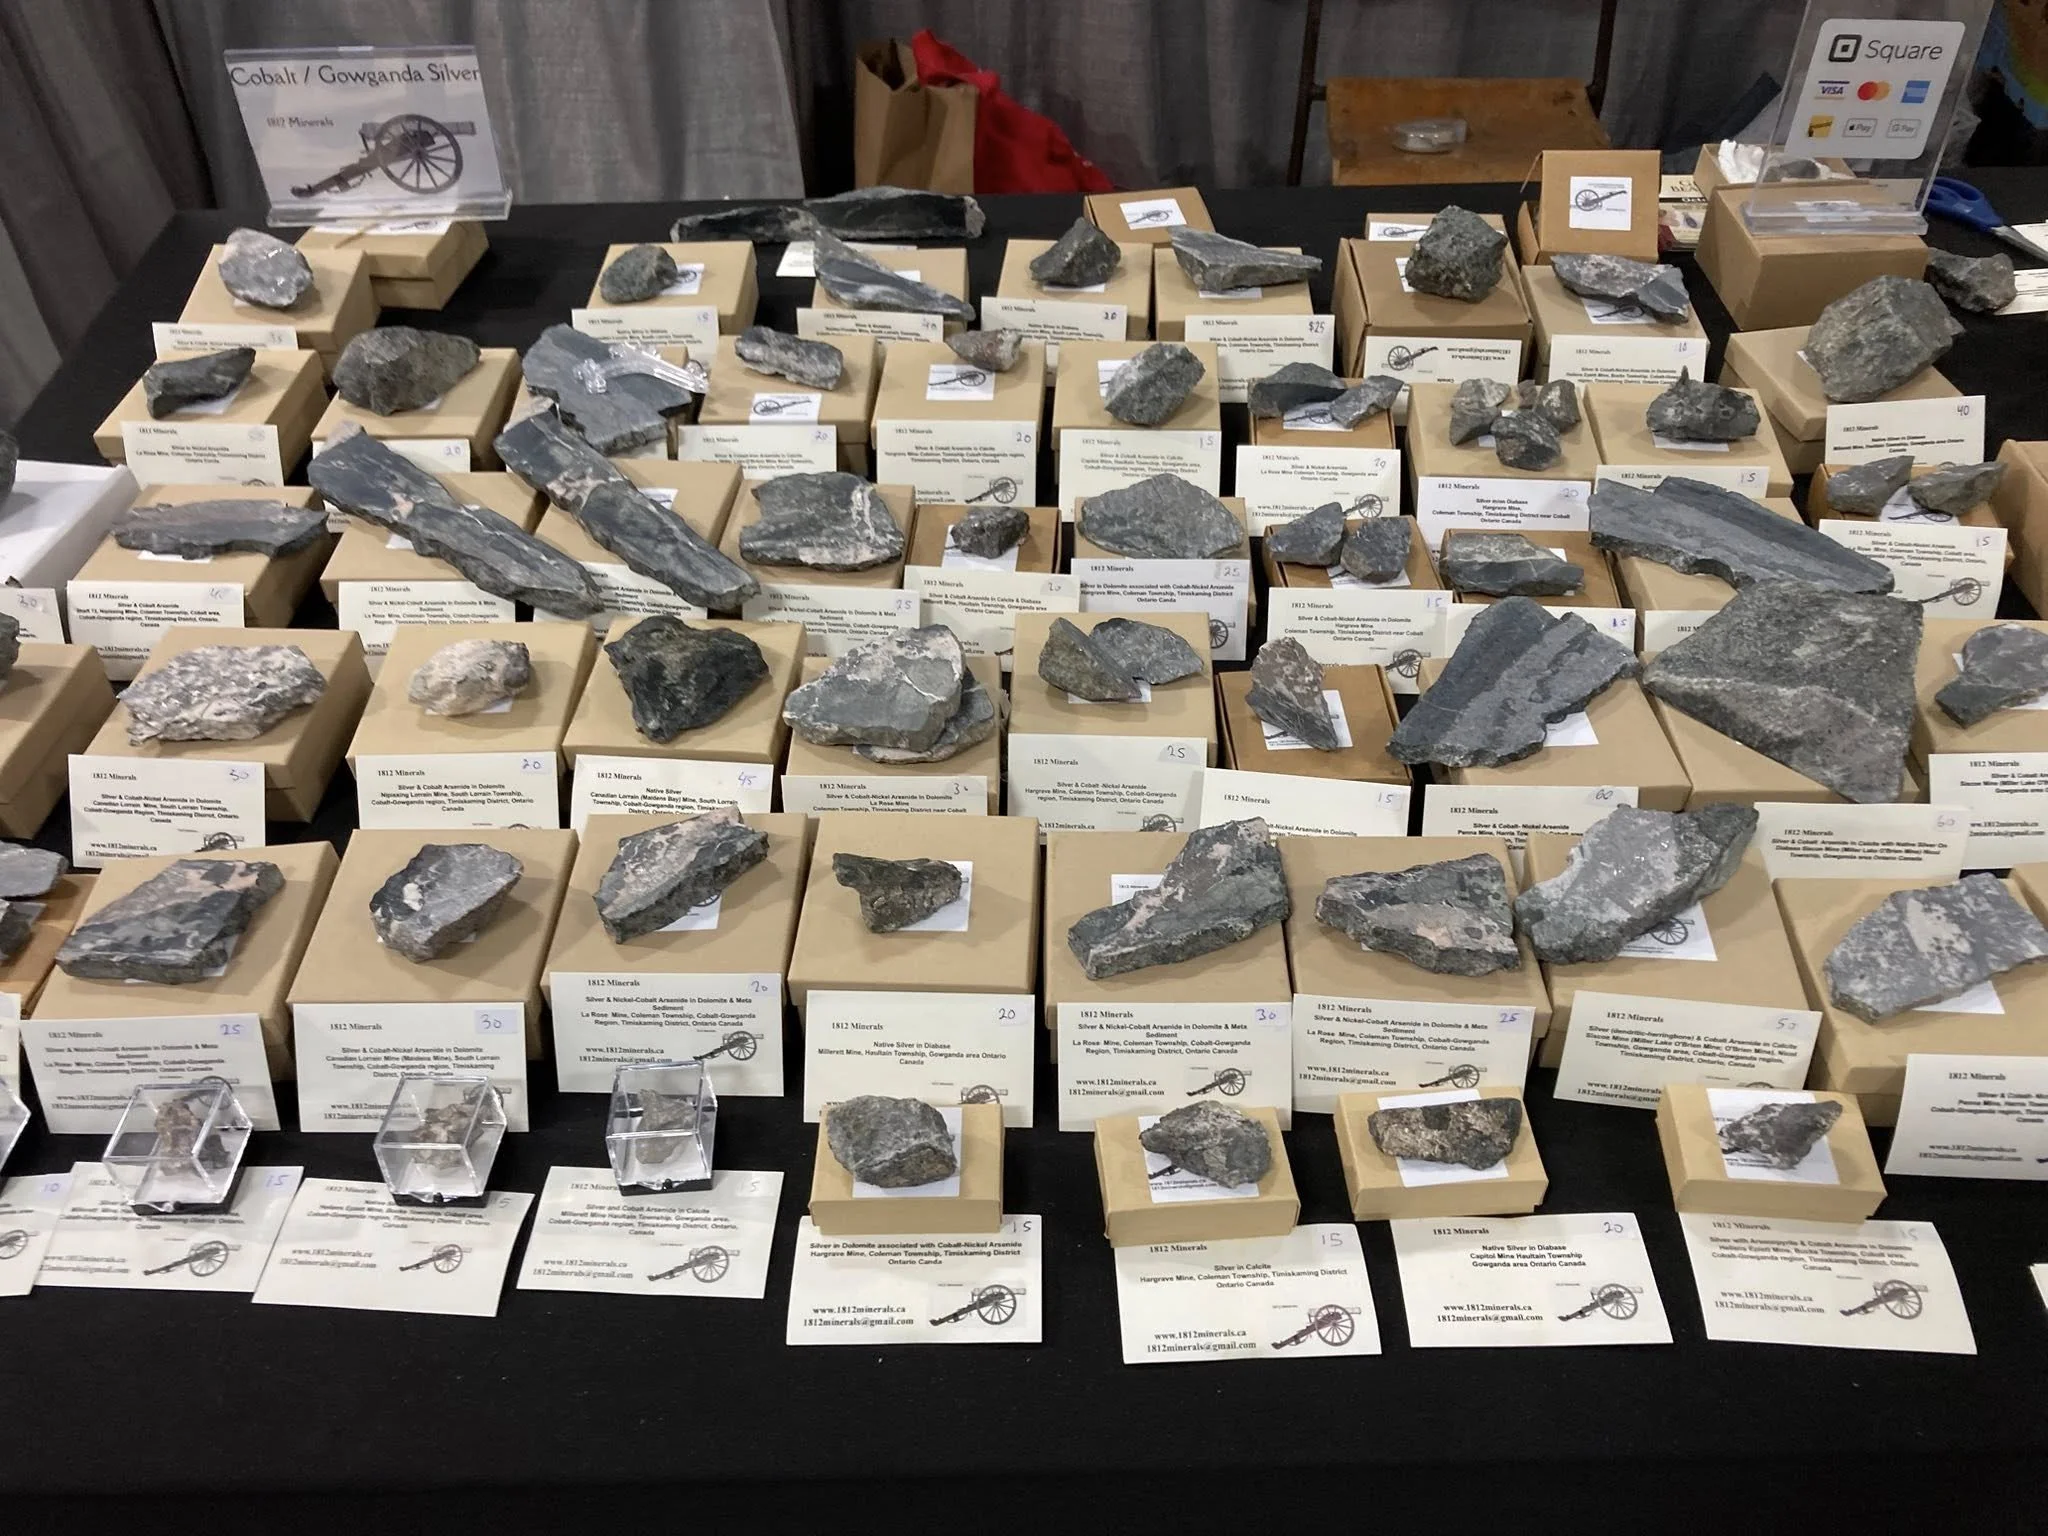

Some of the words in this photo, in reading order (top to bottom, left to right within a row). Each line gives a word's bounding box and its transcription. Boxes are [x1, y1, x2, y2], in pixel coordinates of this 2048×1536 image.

[1865, 40, 1943, 63] Square
[231, 67, 296, 86] Cobalt
[318, 65, 424, 86] Gowganda
[428, 64, 479, 82] Silver
[1821, 87, 1844, 95] VISA
[266, 116, 285, 128] 1812
[1308, 321, 1324, 334] $25
[1957, 405, 1969, 416] 40
[1016, 431, 1032, 444] 20
[1167, 745, 1185, 758] 25
[522, 759, 541, 769] 20
[738, 772, 756, 785] 45
[752, 981, 768, 992] 20
[999, 1008, 1015, 1020] 20
[1337, 1004, 1372, 1013] Minerals
[1256, 1009, 1276, 1020] 30
[1500, 1013, 1519, 1023] 25
[1627, 1013, 1664, 1023] Minerals
[480, 1014, 501, 1029] 30
[221, 1024, 241, 1035] 25
[1603, 1221, 1623, 1234] 20
[1272, 1269, 1319, 1277] Timiskaming
[804, 1317, 913, 1326] 1812minerals@gmail.com
[1154, 1330, 1246, 1339] www.1812minerals.ca
[1147, 1341, 1256, 1352] 1812minerals@gmail.com
